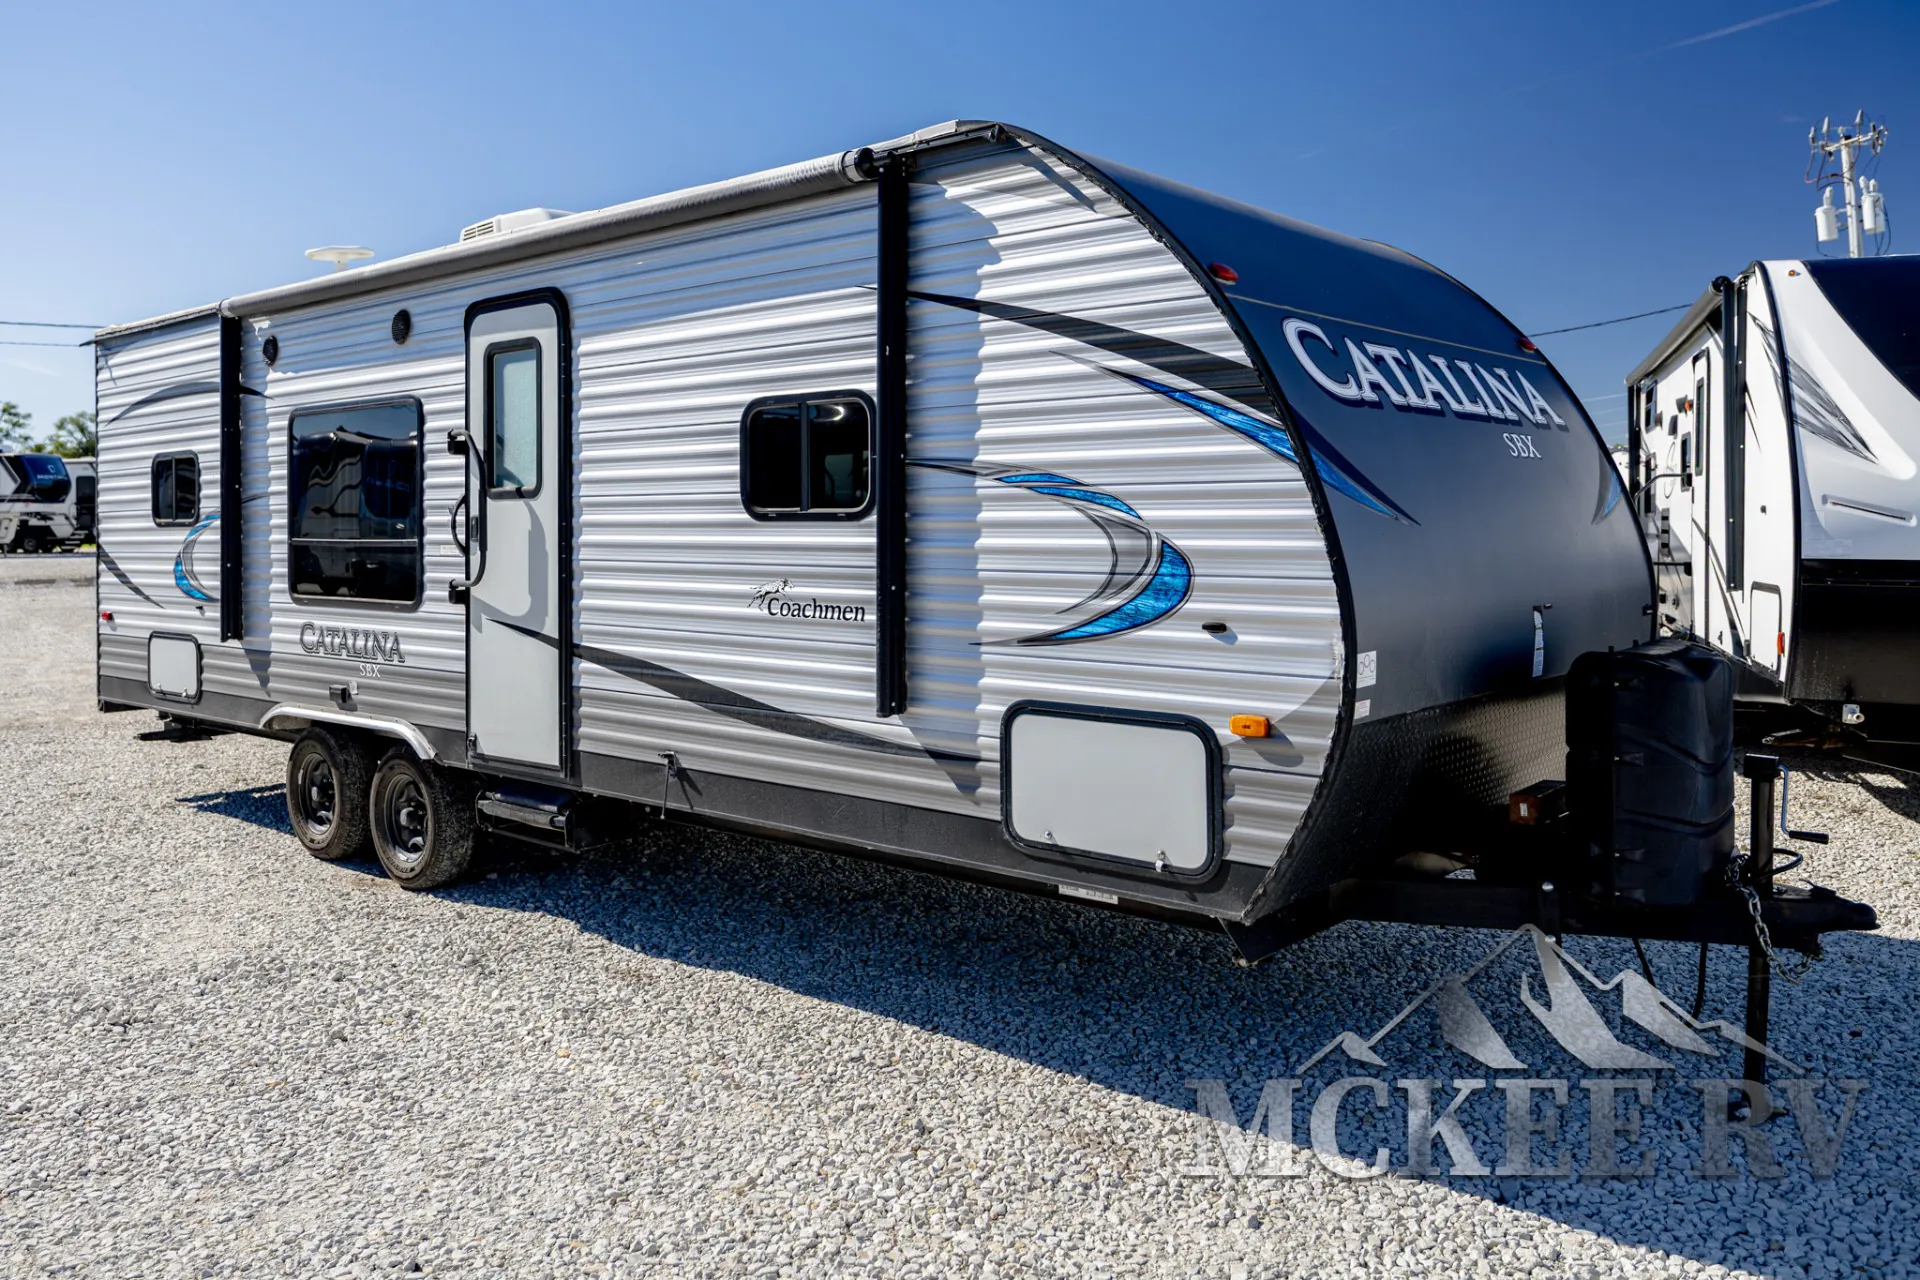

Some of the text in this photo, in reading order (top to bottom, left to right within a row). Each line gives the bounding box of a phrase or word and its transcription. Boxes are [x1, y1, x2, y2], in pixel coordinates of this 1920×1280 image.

[1281, 316, 1567, 427] CATALINA
[1503, 432, 1542, 459] SBX
[767, 597, 865, 622] Coachmen
[299, 621, 405, 664] CATALINA
[359, 663, 381, 678] SBX
